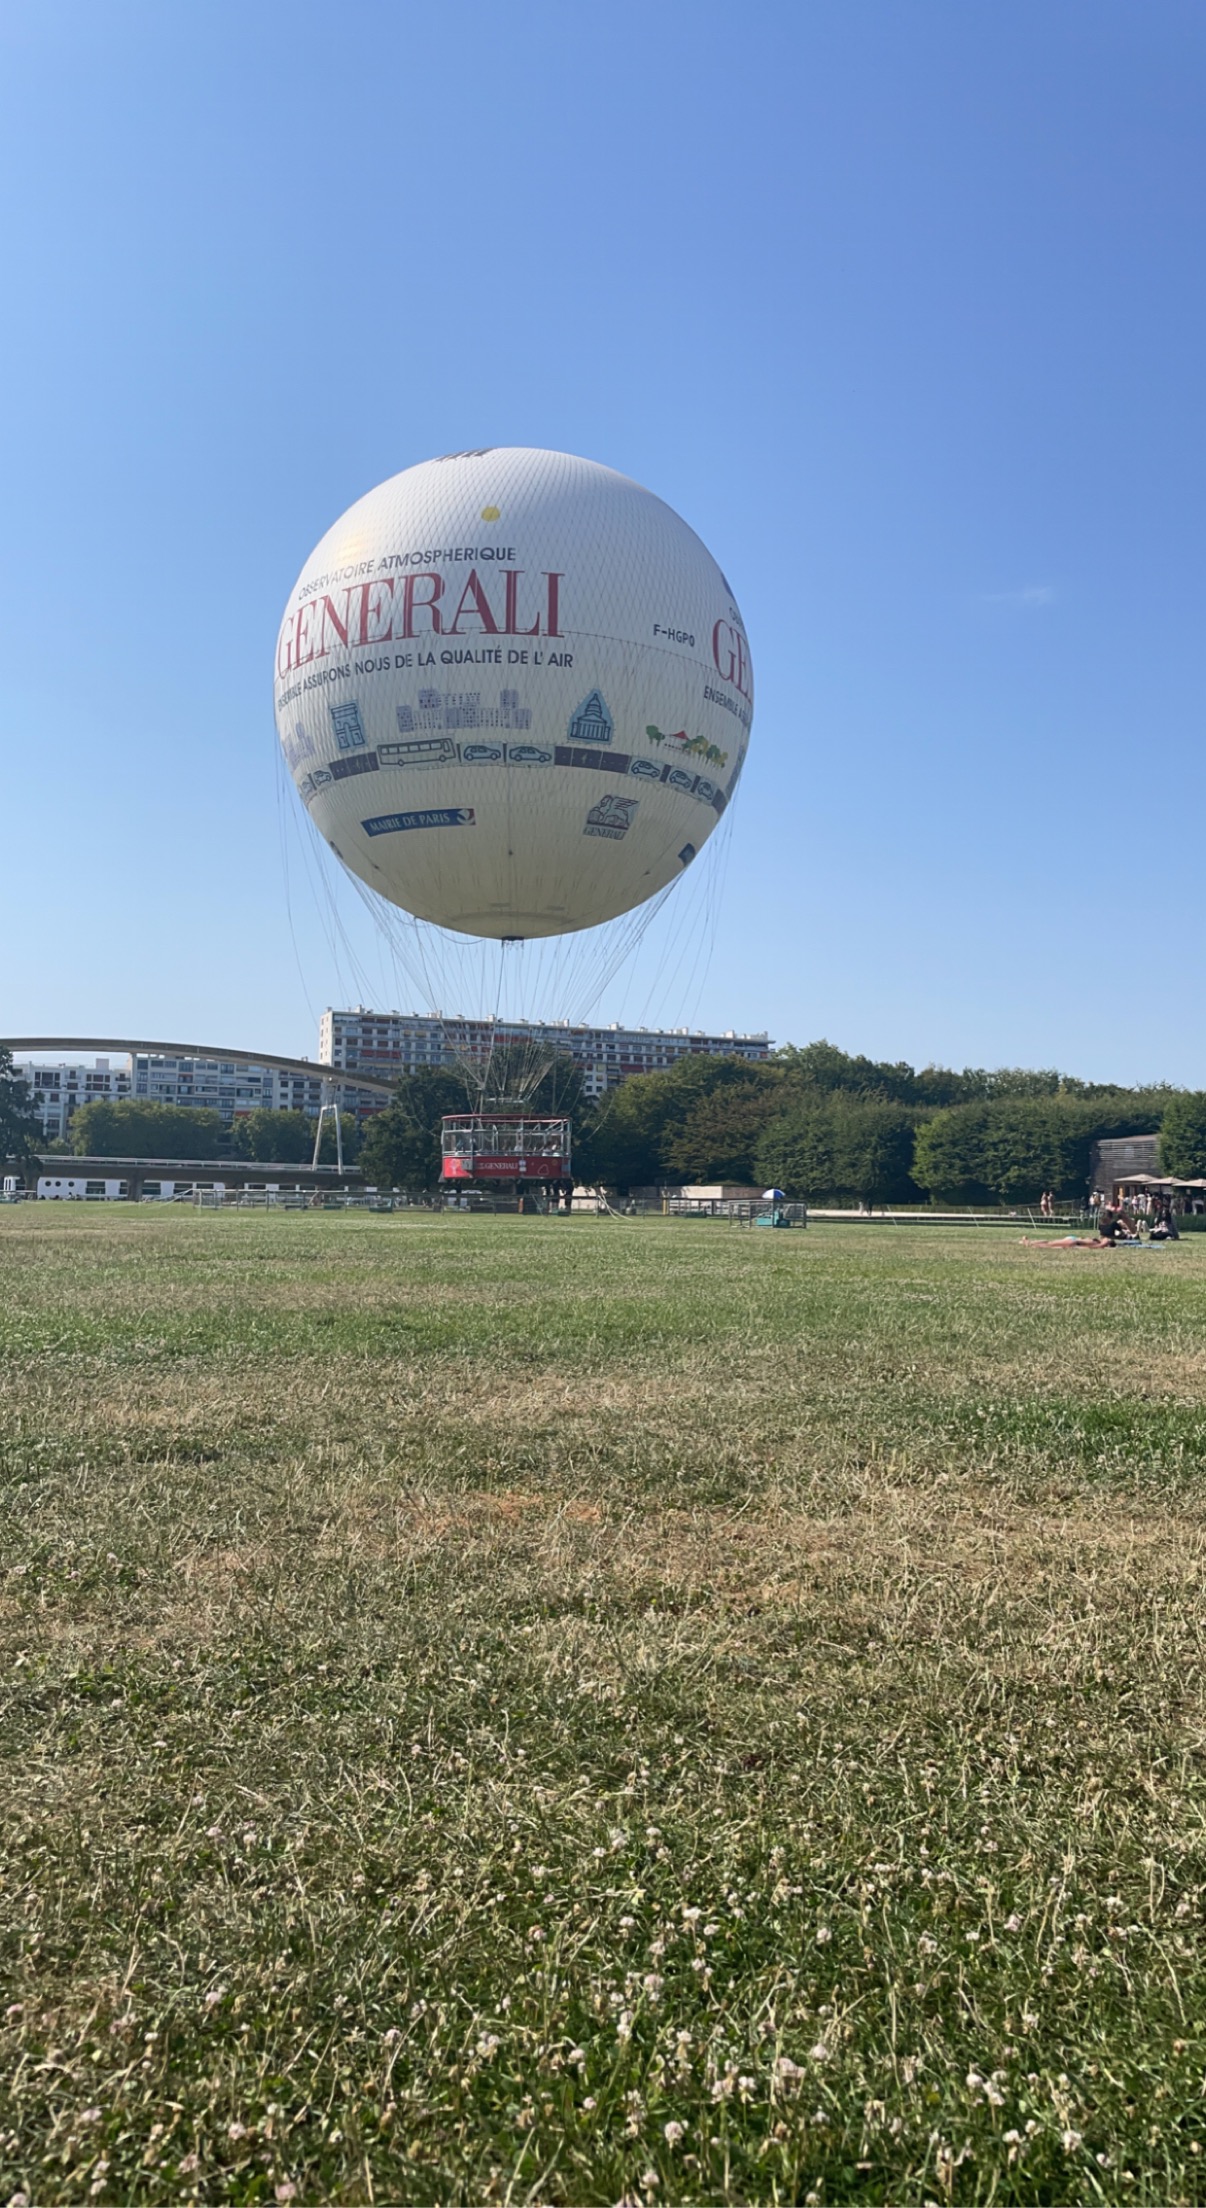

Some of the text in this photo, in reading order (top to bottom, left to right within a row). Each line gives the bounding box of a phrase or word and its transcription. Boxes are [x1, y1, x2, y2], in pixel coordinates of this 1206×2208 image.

[298, 547, 517, 601] OBSERVATOIRE ATMOSPHERIQUE
[278, 568, 566, 680] GENERALI
[303, 663, 351, 692] ASSURONS
[355, 656, 391, 676] NOUS
[395, 653, 413, 669] DE
[417, 651, 436, 667] LA
[440, 645, 502, 664] QUALITÉ
[507, 650, 528, 665] DE
[369, 812, 450, 832] MAIRIE DE PARIS
[583, 826, 627, 841] GENERALI
[485, 1162, 518, 1170] GENERALI
